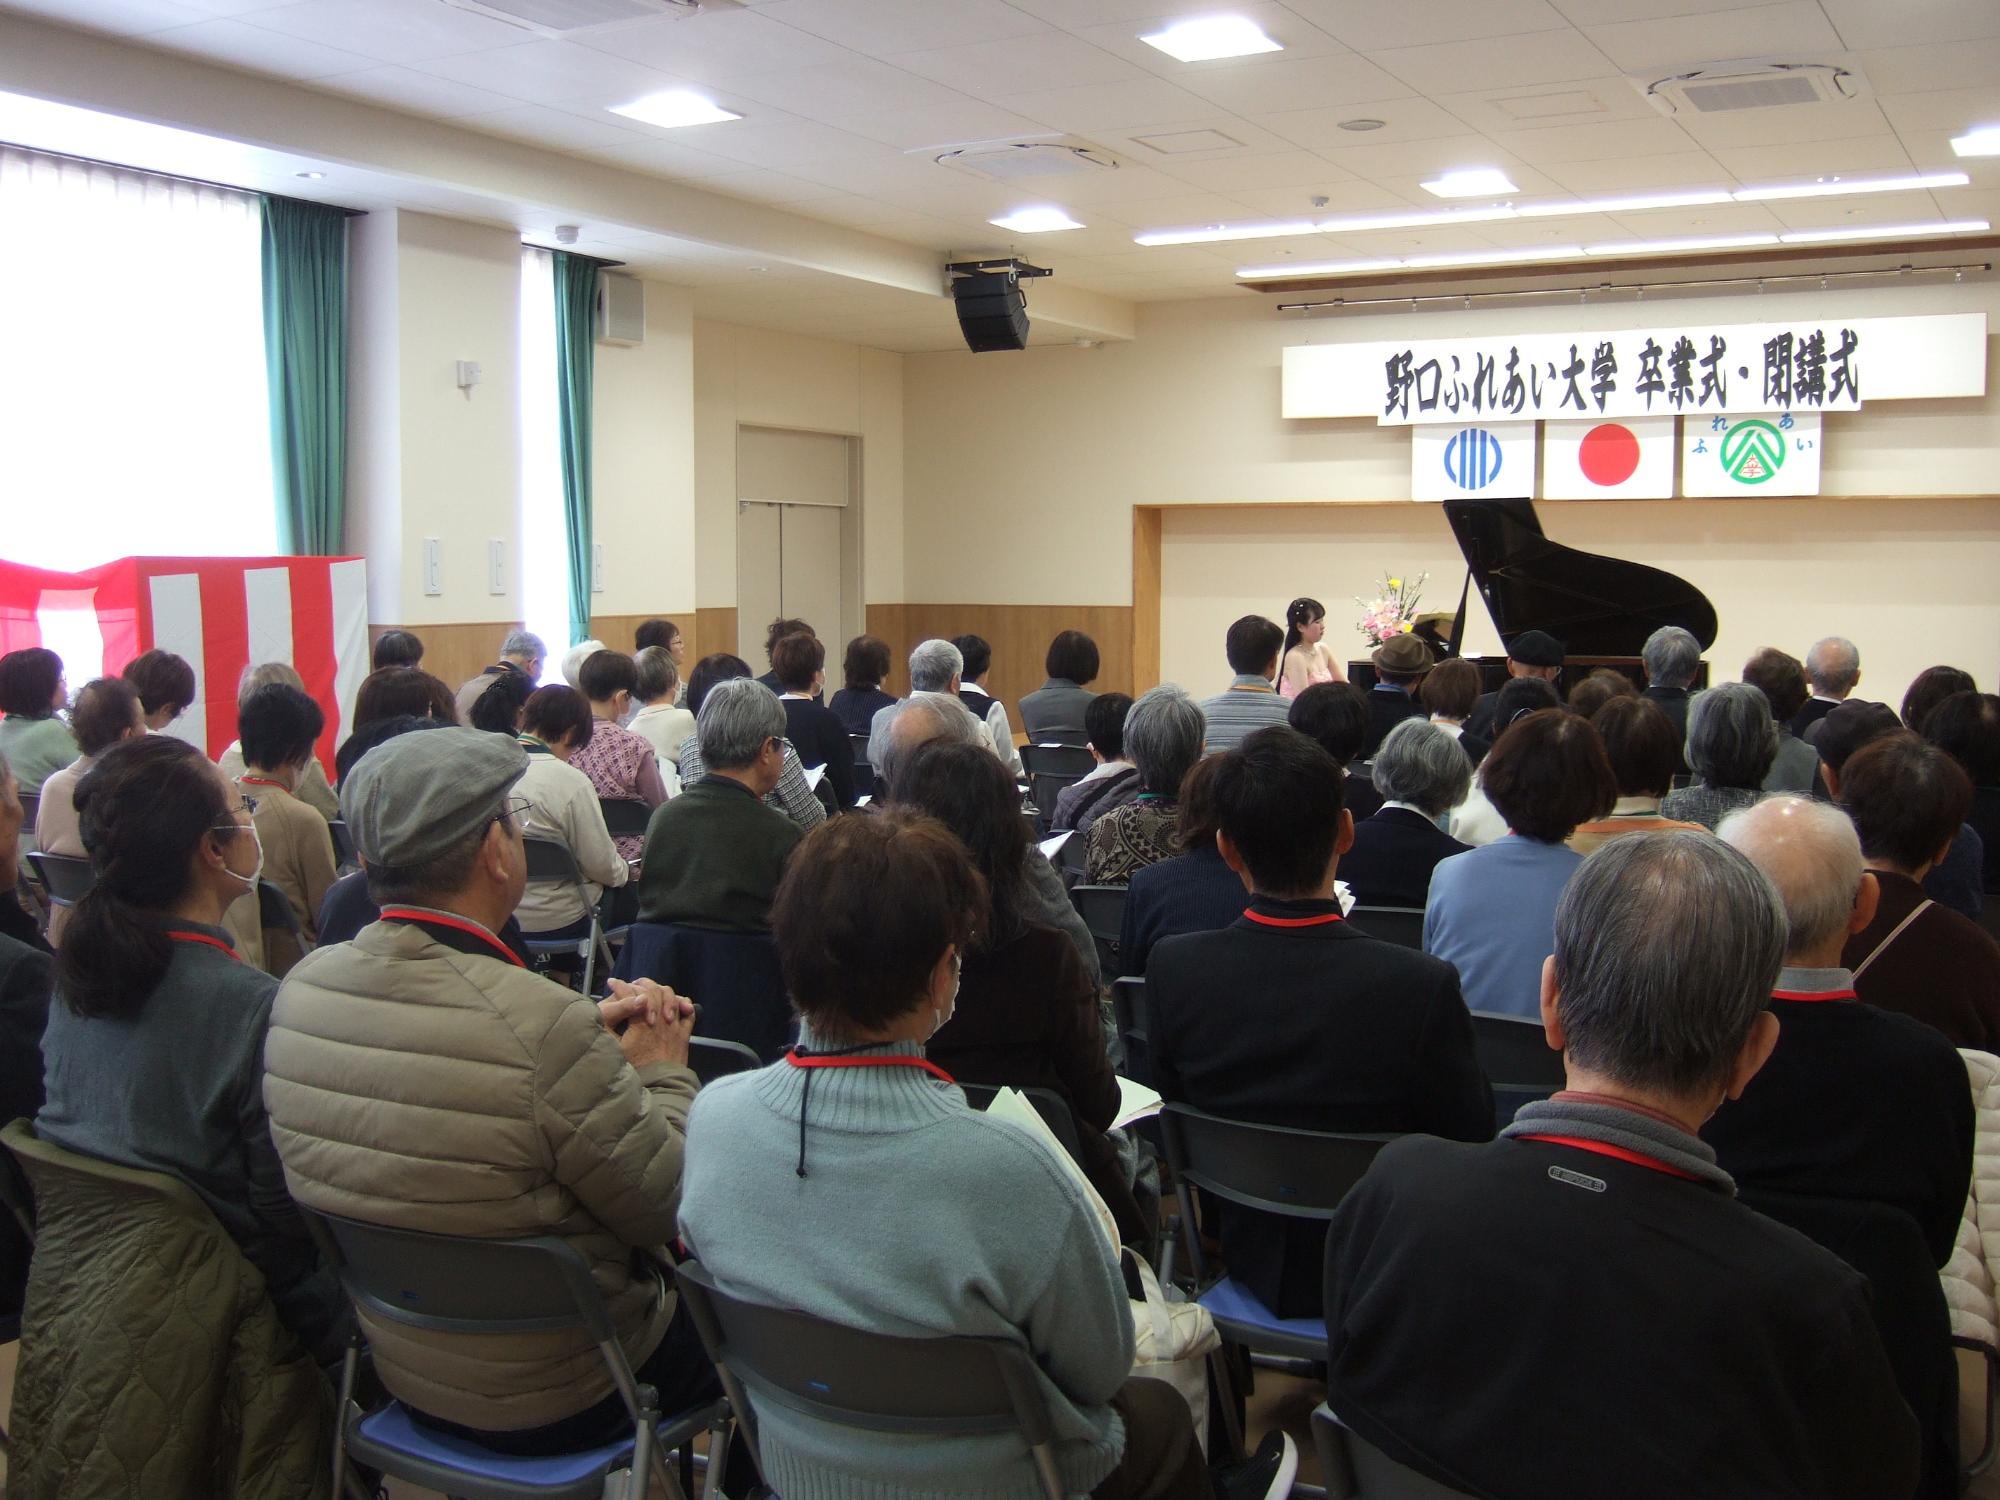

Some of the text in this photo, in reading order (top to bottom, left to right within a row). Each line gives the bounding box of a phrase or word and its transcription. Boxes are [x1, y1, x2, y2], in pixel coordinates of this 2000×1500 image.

[1385, 328, 1859, 420] 野口ふれあい大学 卒業式・閉講式
